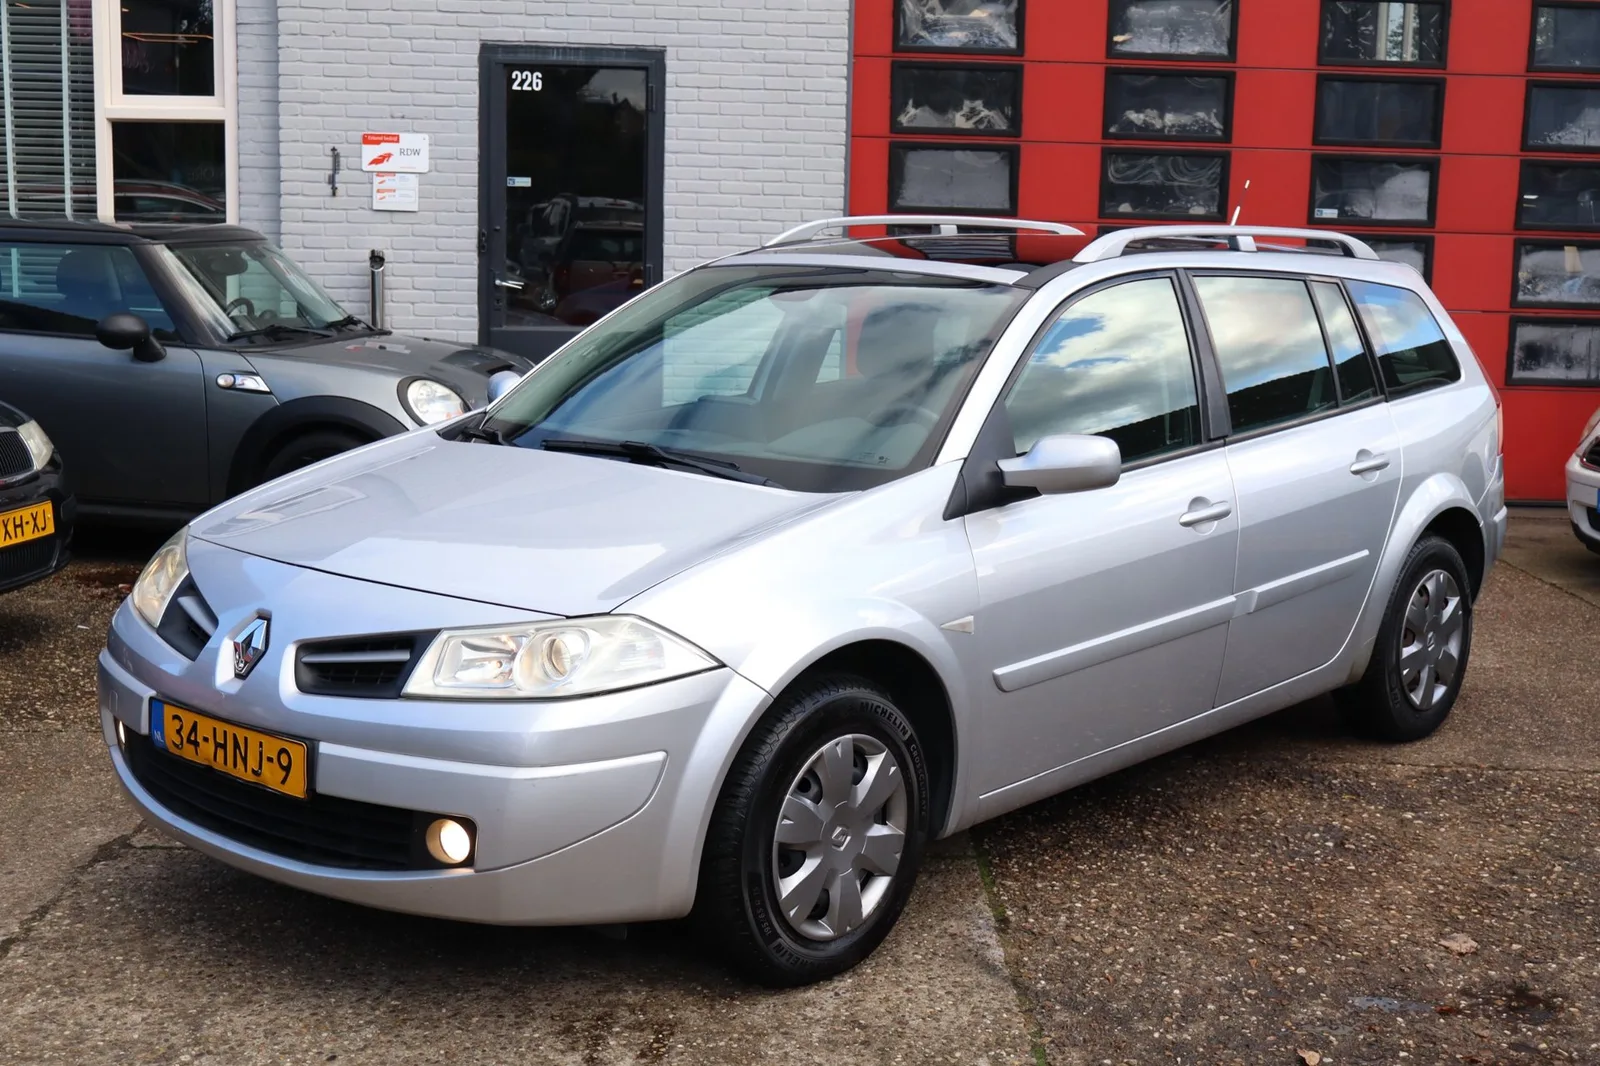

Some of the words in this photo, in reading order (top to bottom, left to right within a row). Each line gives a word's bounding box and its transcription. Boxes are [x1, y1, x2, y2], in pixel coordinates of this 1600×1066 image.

[511, 70, 543, 92] 226
[399, 147, 422, 157] RDW
[859, 701, 909, 737] MICHELIN
[153, 730, 164, 744] NL
[171, 713, 293, 786] 34-HNJ-9
